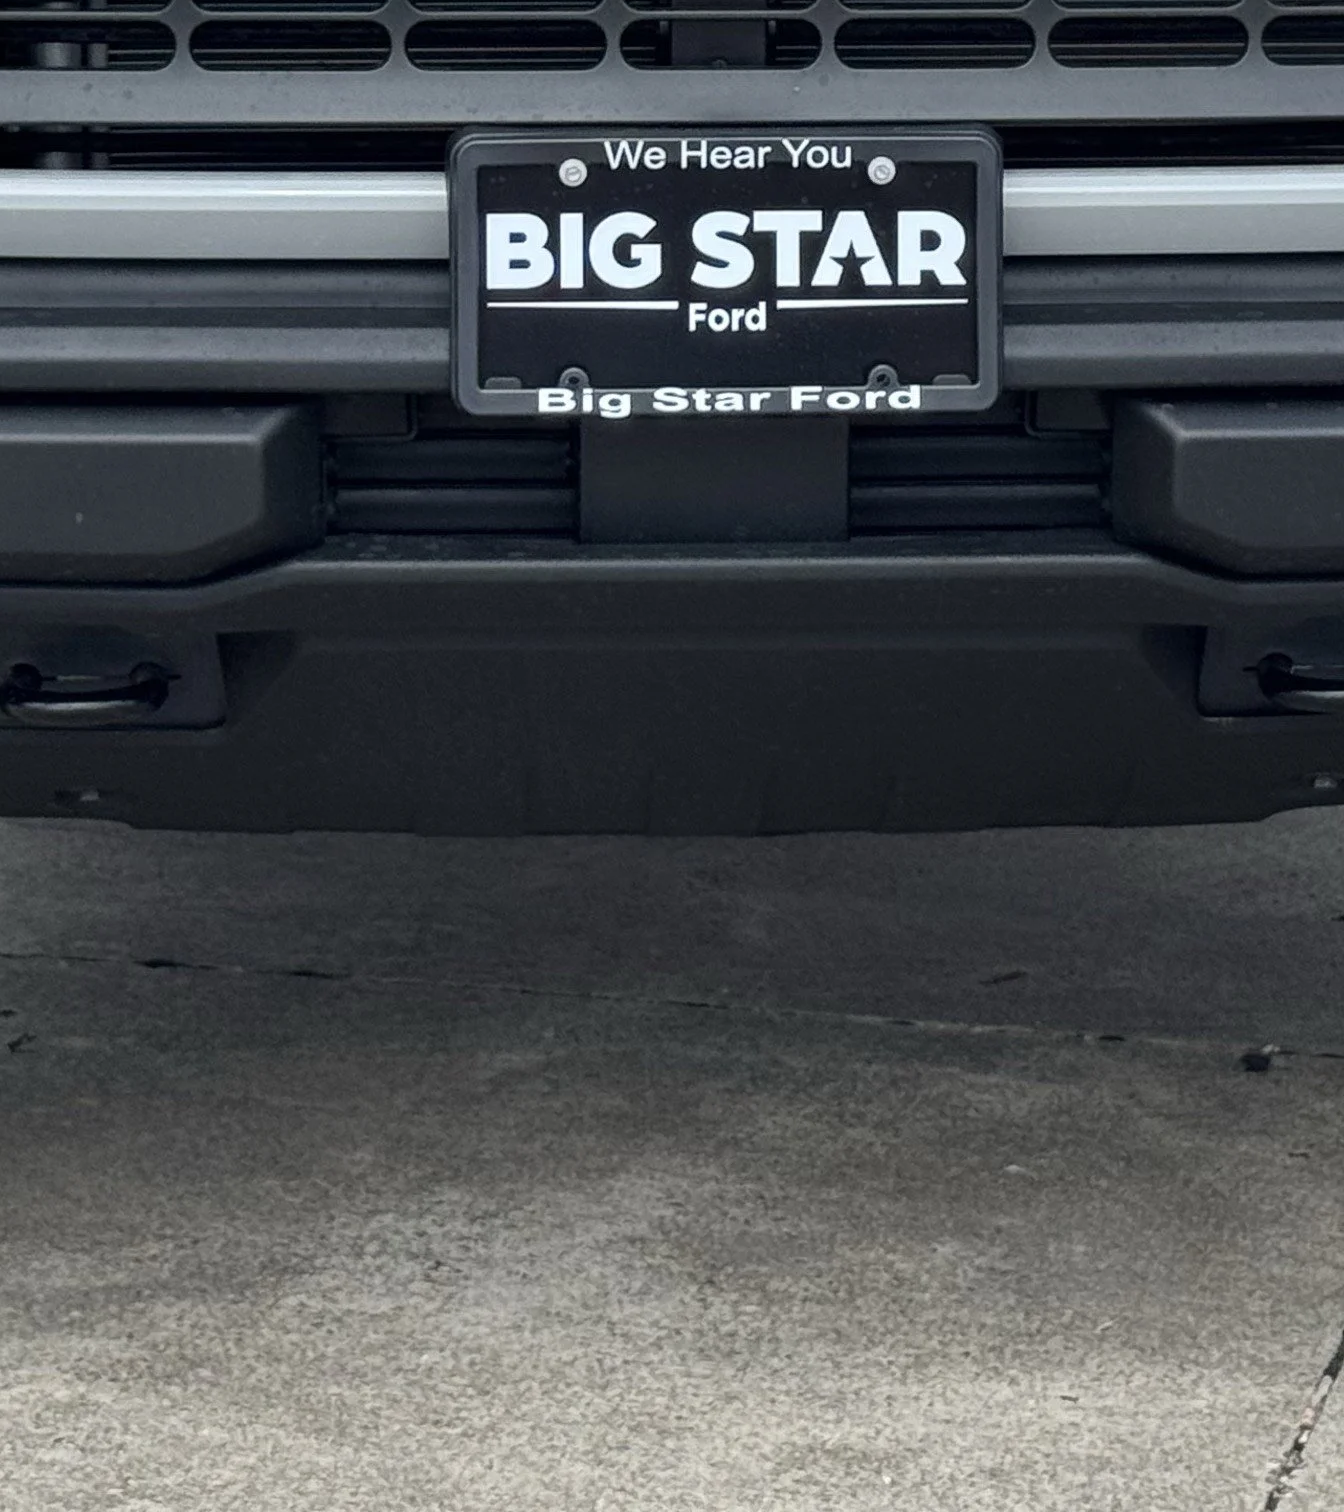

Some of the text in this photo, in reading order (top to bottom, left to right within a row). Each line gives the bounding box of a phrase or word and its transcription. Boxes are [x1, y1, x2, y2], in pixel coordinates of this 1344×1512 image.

[603, 138, 853, 169] We Hear You
[485, 210, 968, 290] BIG STAR
[688, 302, 767, 332] Ford
[537, 386, 922, 419] Big Star Ford
